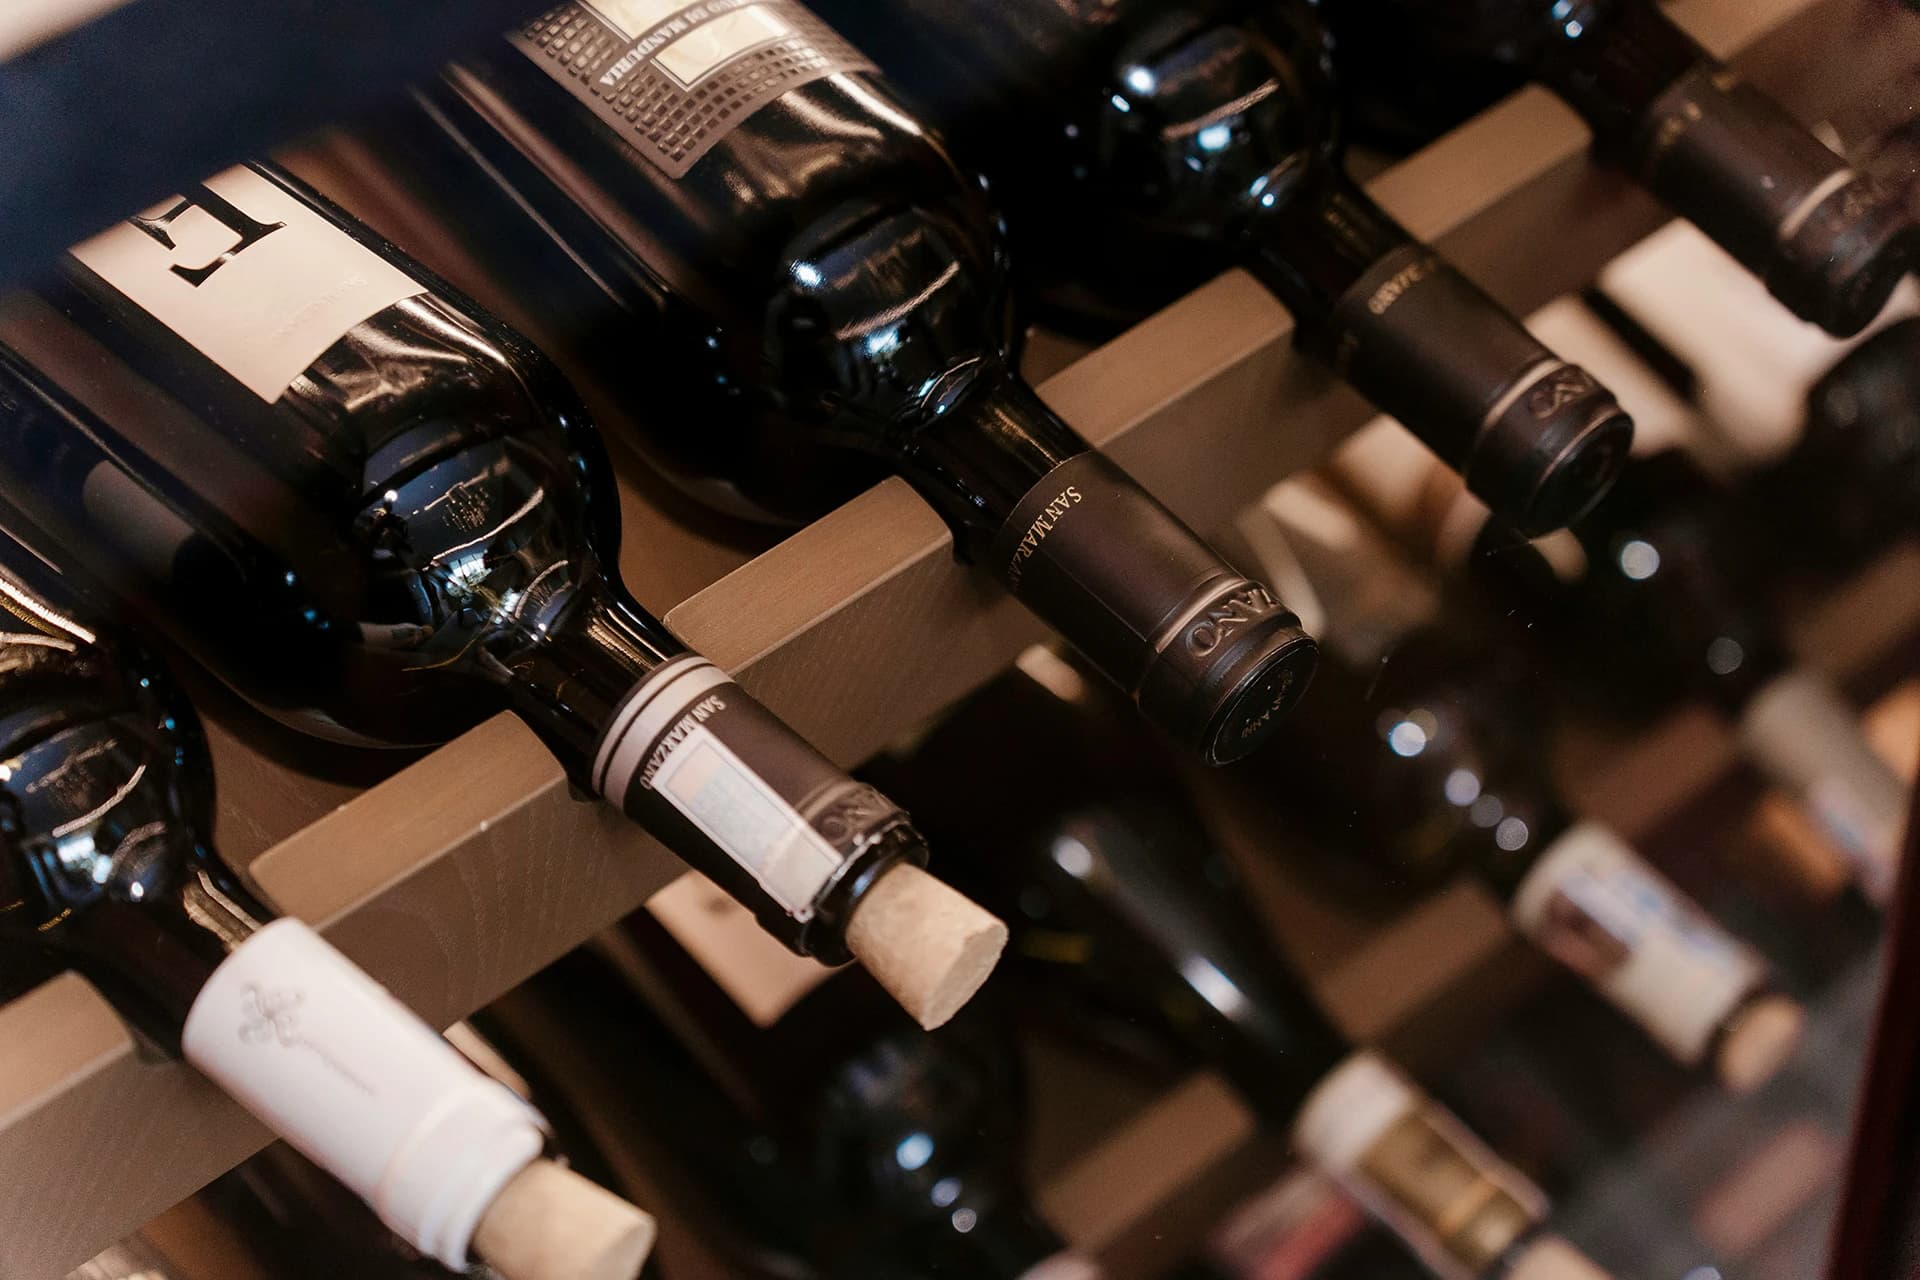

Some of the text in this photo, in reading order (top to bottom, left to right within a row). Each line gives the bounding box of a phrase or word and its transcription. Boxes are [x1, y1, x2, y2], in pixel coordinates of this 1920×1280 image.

[599, 19, 689, 86] MANDURIA
[1044, 485, 1082, 522] SAN
[691, 694, 726, 722] SAN
